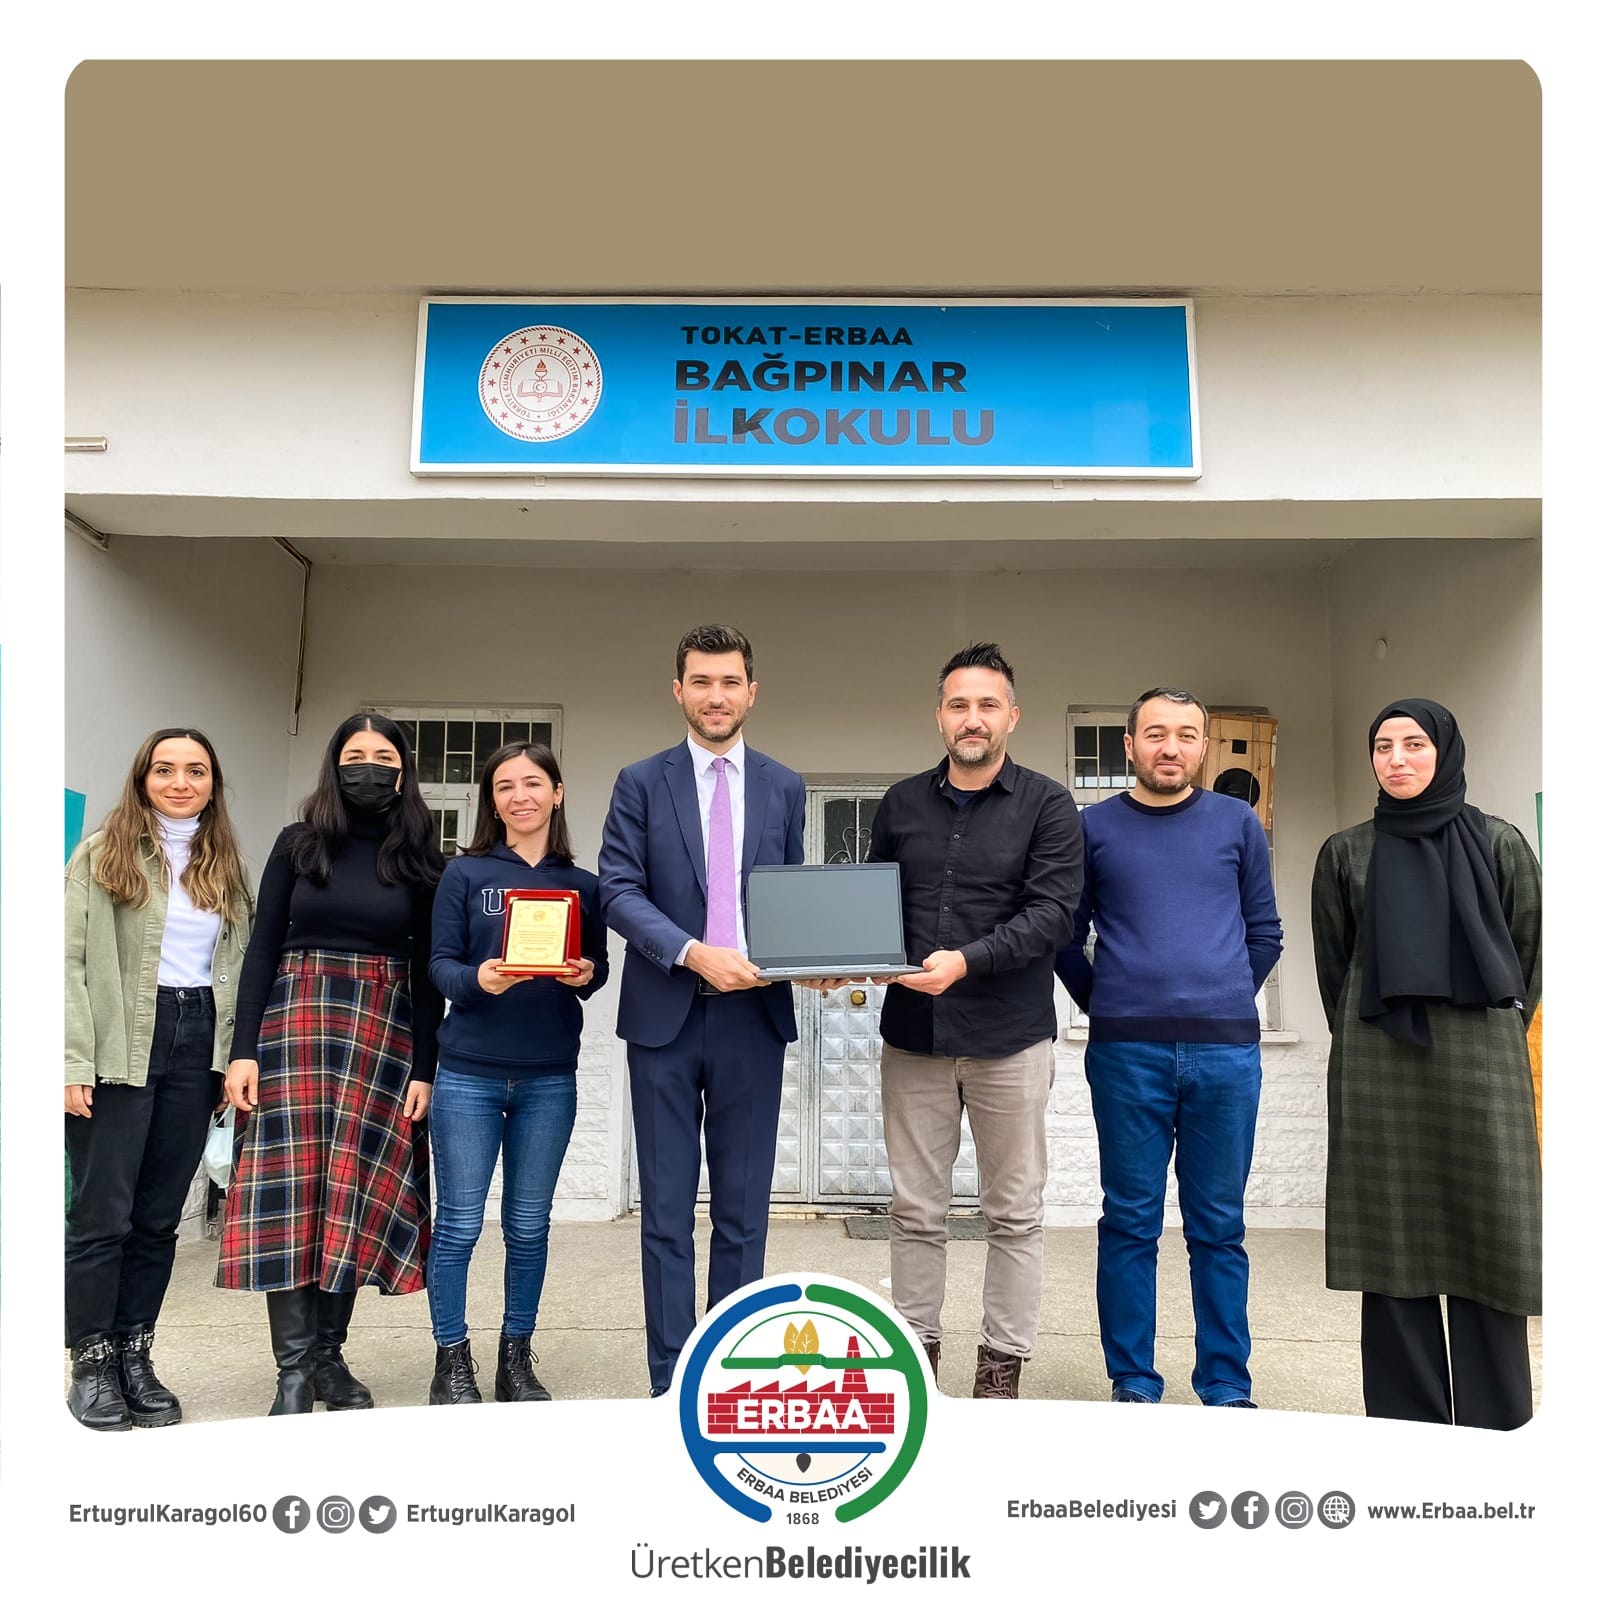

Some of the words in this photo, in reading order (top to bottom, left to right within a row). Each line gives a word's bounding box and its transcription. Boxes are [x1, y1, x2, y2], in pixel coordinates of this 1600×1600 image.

[682, 325, 913, 346] TOKAT-ERBAA
[675, 352, 967, 393] BAĞPINAR
[673, 400, 996, 446] İLKOKULU
